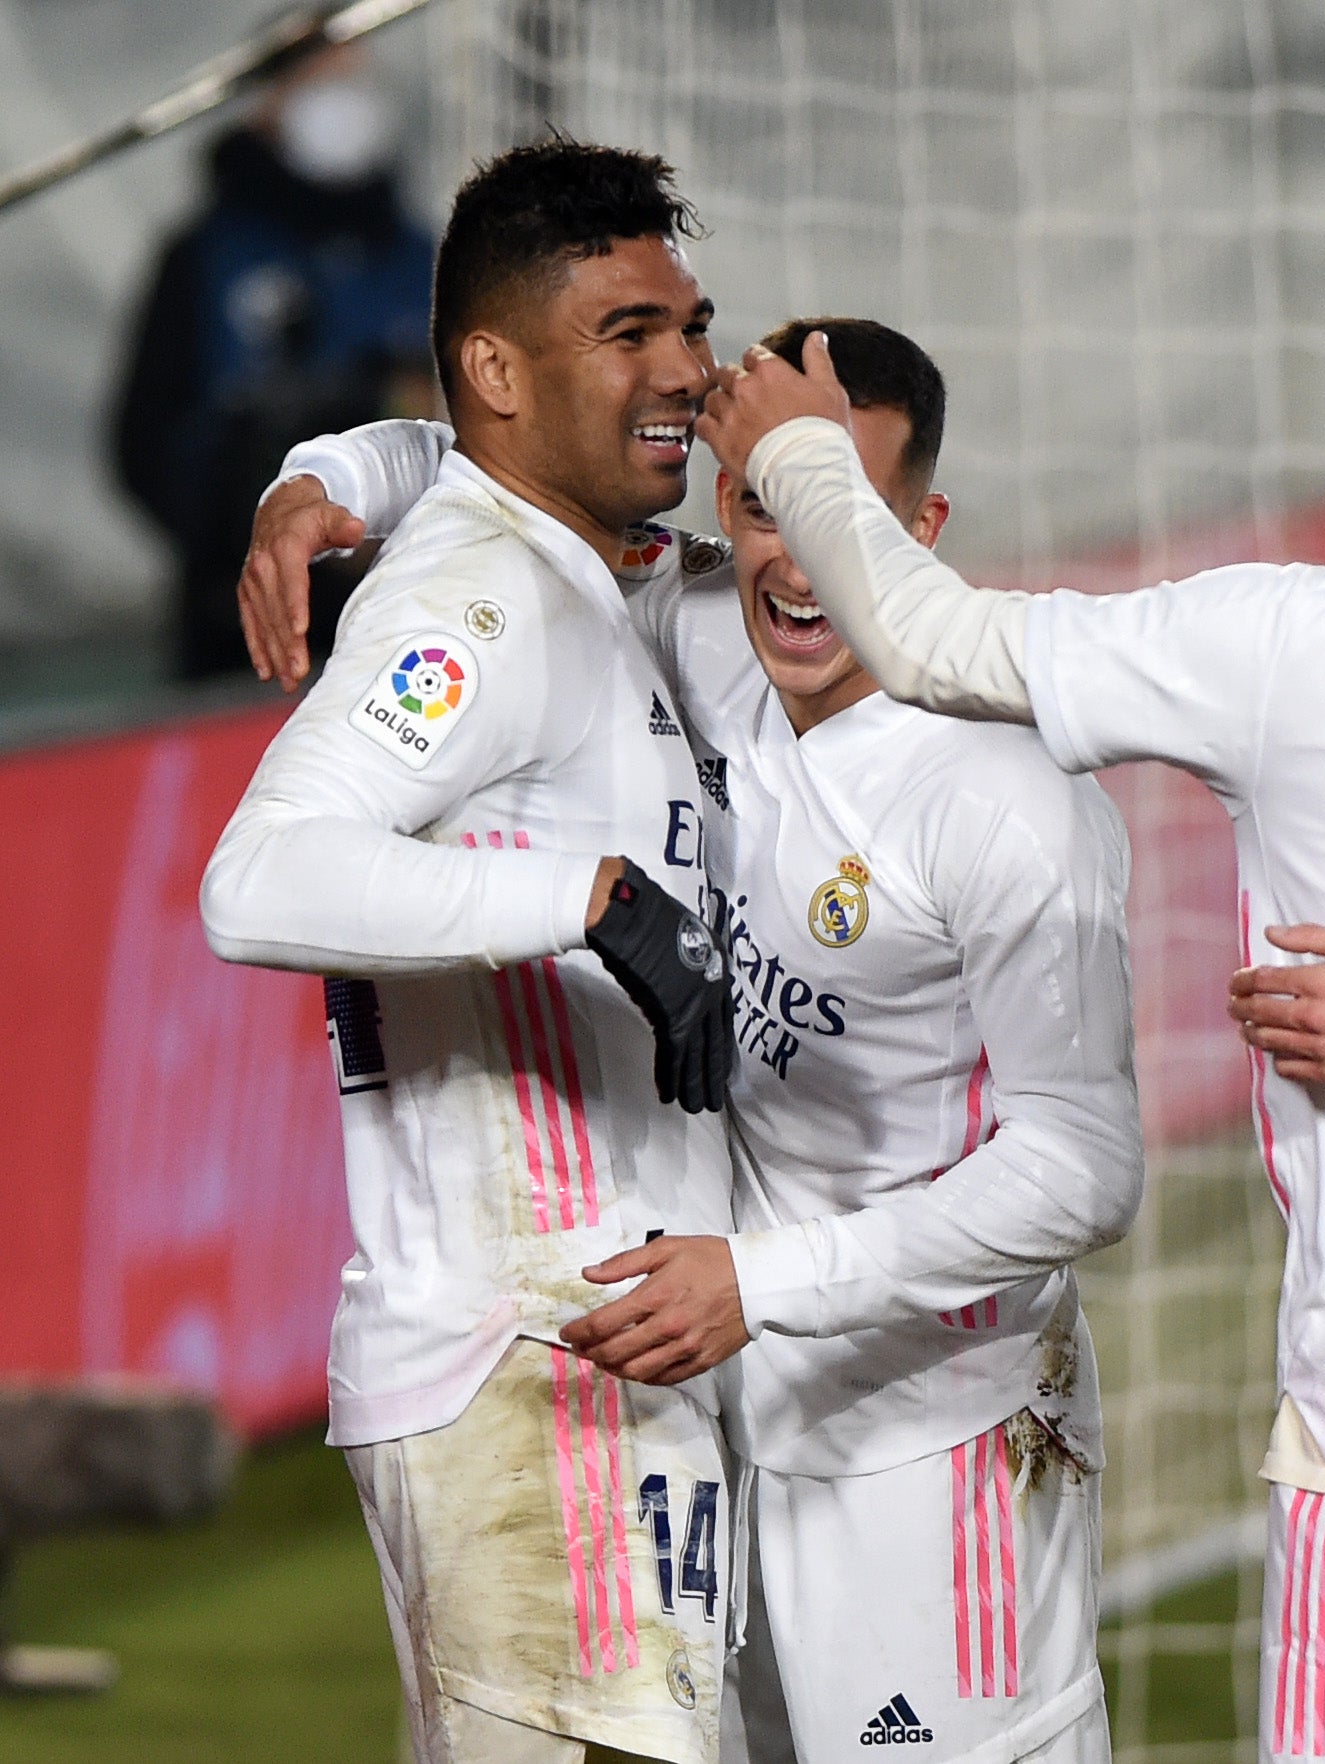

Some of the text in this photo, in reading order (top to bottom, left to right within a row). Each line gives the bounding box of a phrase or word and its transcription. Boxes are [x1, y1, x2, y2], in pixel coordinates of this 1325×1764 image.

[364, 698, 430, 753] LaLiga
[638, 1473, 721, 1624] 14
[859, 1725, 934, 1746] adidas
